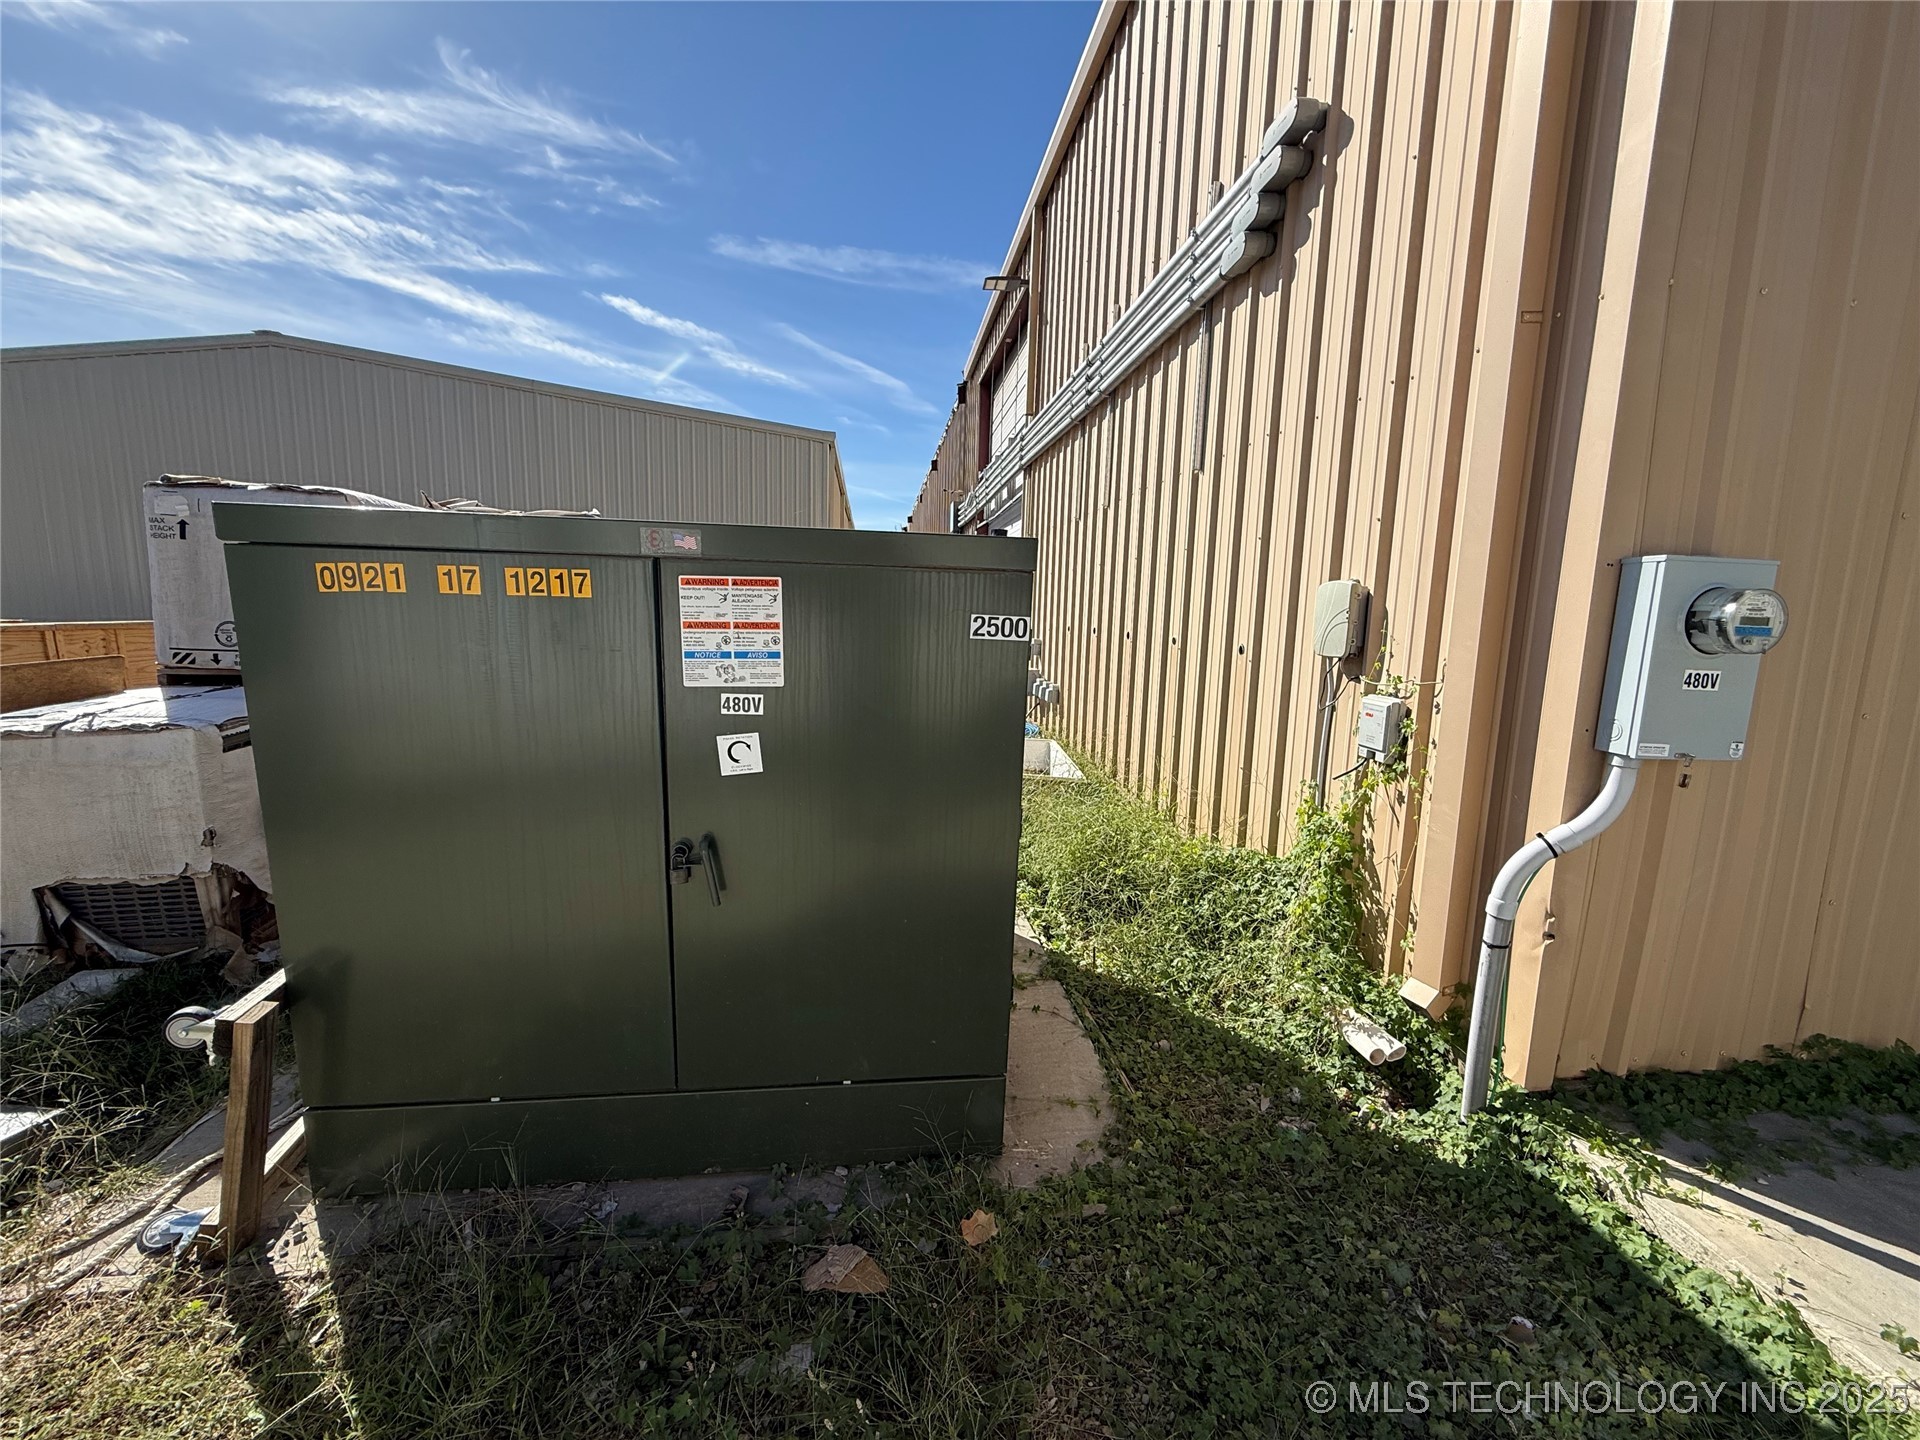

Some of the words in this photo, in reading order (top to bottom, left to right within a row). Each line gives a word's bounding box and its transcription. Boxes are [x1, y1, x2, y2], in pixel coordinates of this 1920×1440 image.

[319, 566, 402, 590] 0921
[442, 569, 477, 591] 17
[509, 571, 588, 594] 1217
[691, 578, 725, 586] WARNING
[739, 579, 778, 587] ADVERTENCIA
[972, 616, 1028, 638] 2500
[694, 651, 722, 659] NOTICE
[747, 651, 768, 659] AVISO
[1684, 672, 1720, 689] 480V
[722, 697, 762, 713] 480V
